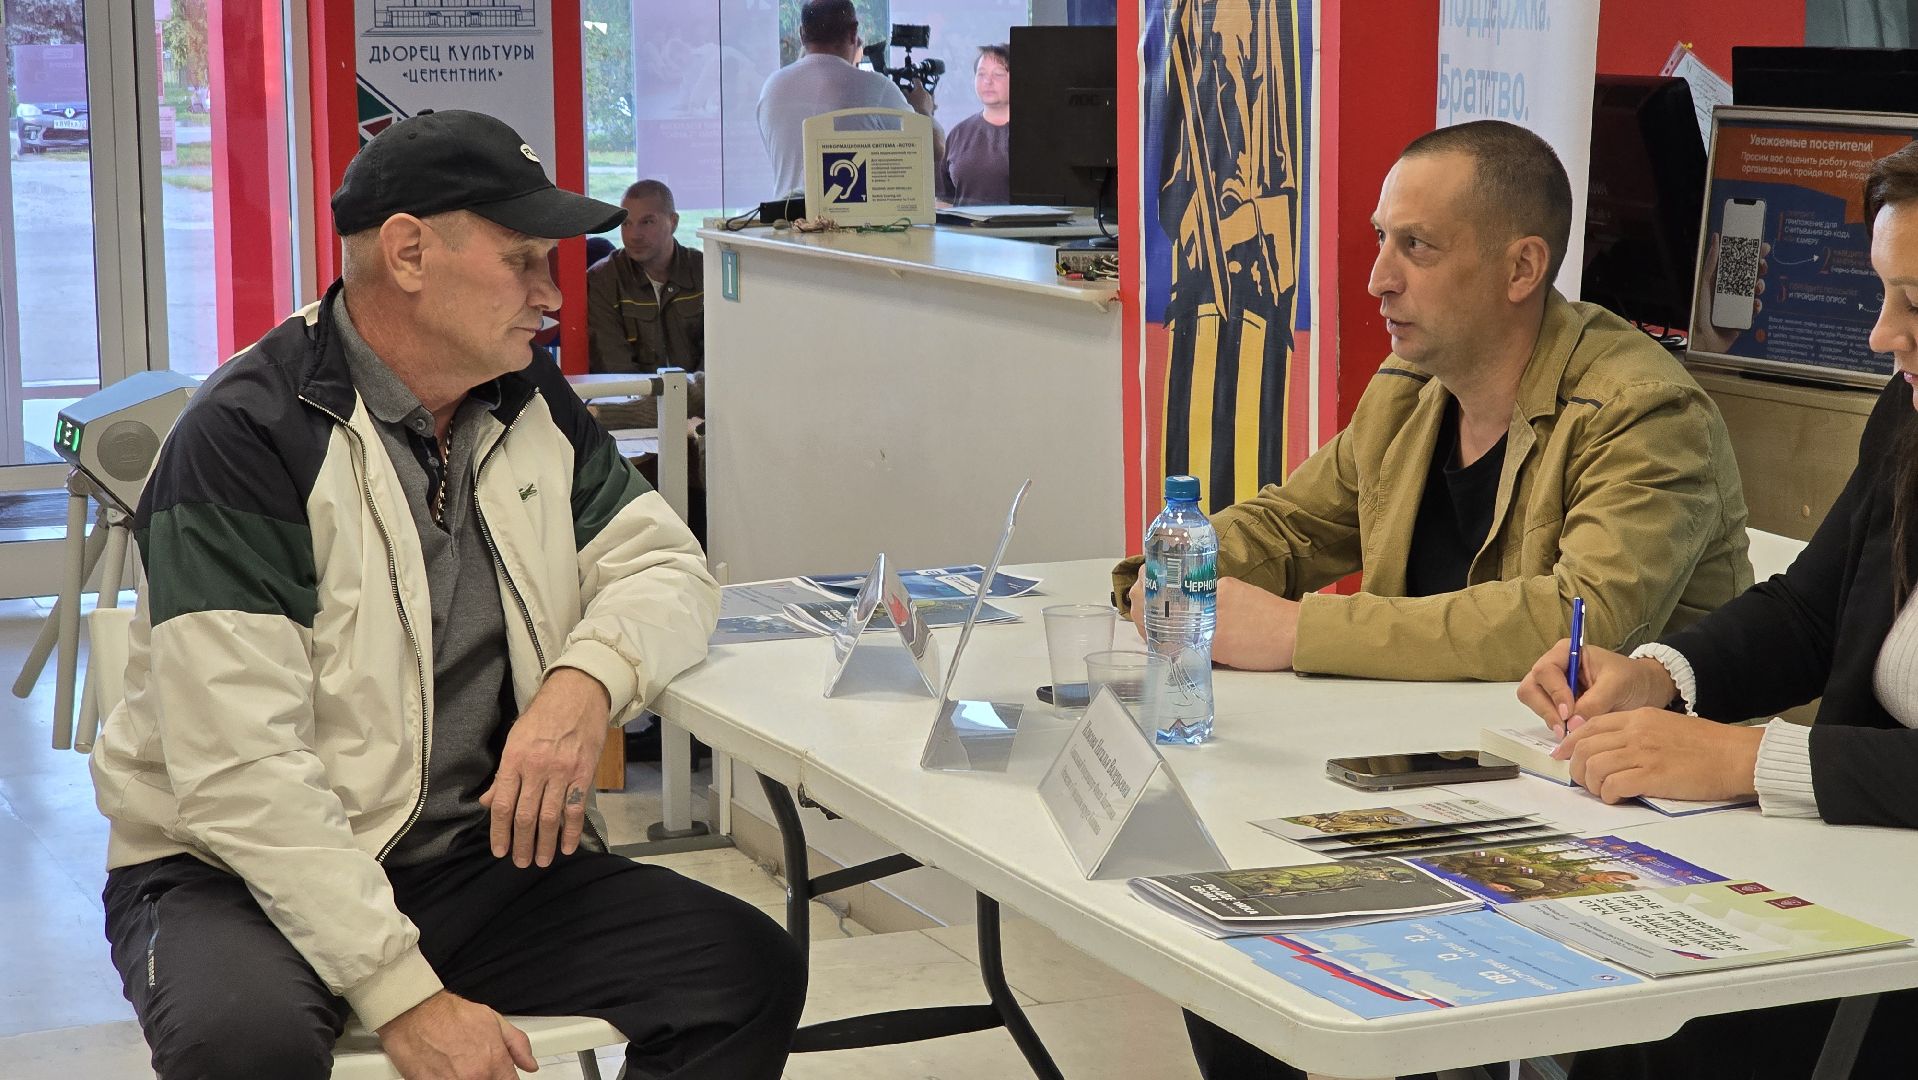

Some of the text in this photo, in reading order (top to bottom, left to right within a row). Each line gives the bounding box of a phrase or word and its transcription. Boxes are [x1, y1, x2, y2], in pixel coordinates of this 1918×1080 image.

[368, 44, 535, 64] ДВОРЕЦ КУЛЬТУРЫ
[402, 68, 503, 83] «ЦЕМЕНТНИК»
[1438, 53, 1530, 124] Братство.
[1750, 134, 1874, 153] Уважаемые посетители!
[1741, 151, 1769, 162] Просим
[1771, 156, 1784, 164] вас
[1786, 156, 1818, 166] оценить
[1819, 157, 1847, 169] работу
[1741, 164, 1793, 177] организации,
[1794, 167, 1823, 178] пройдя
[1794, 292, 1825, 303] ПРОЙДИТЕ
[1826, 296, 1847, 305] ОПРОС
[1619, 916, 1690, 948] ОТЕЧЕСТВА
[1636, 914, 1725, 951] ЗАЩИТНИКОВ
[1652, 912, 1721, 942] ГАРАНТИИ
[1718, 939, 1751, 952] ДЛЯ
[1669, 910, 1742, 940] ПРАВОВЫЕ
[1478, 970, 1517, 985] СВО
